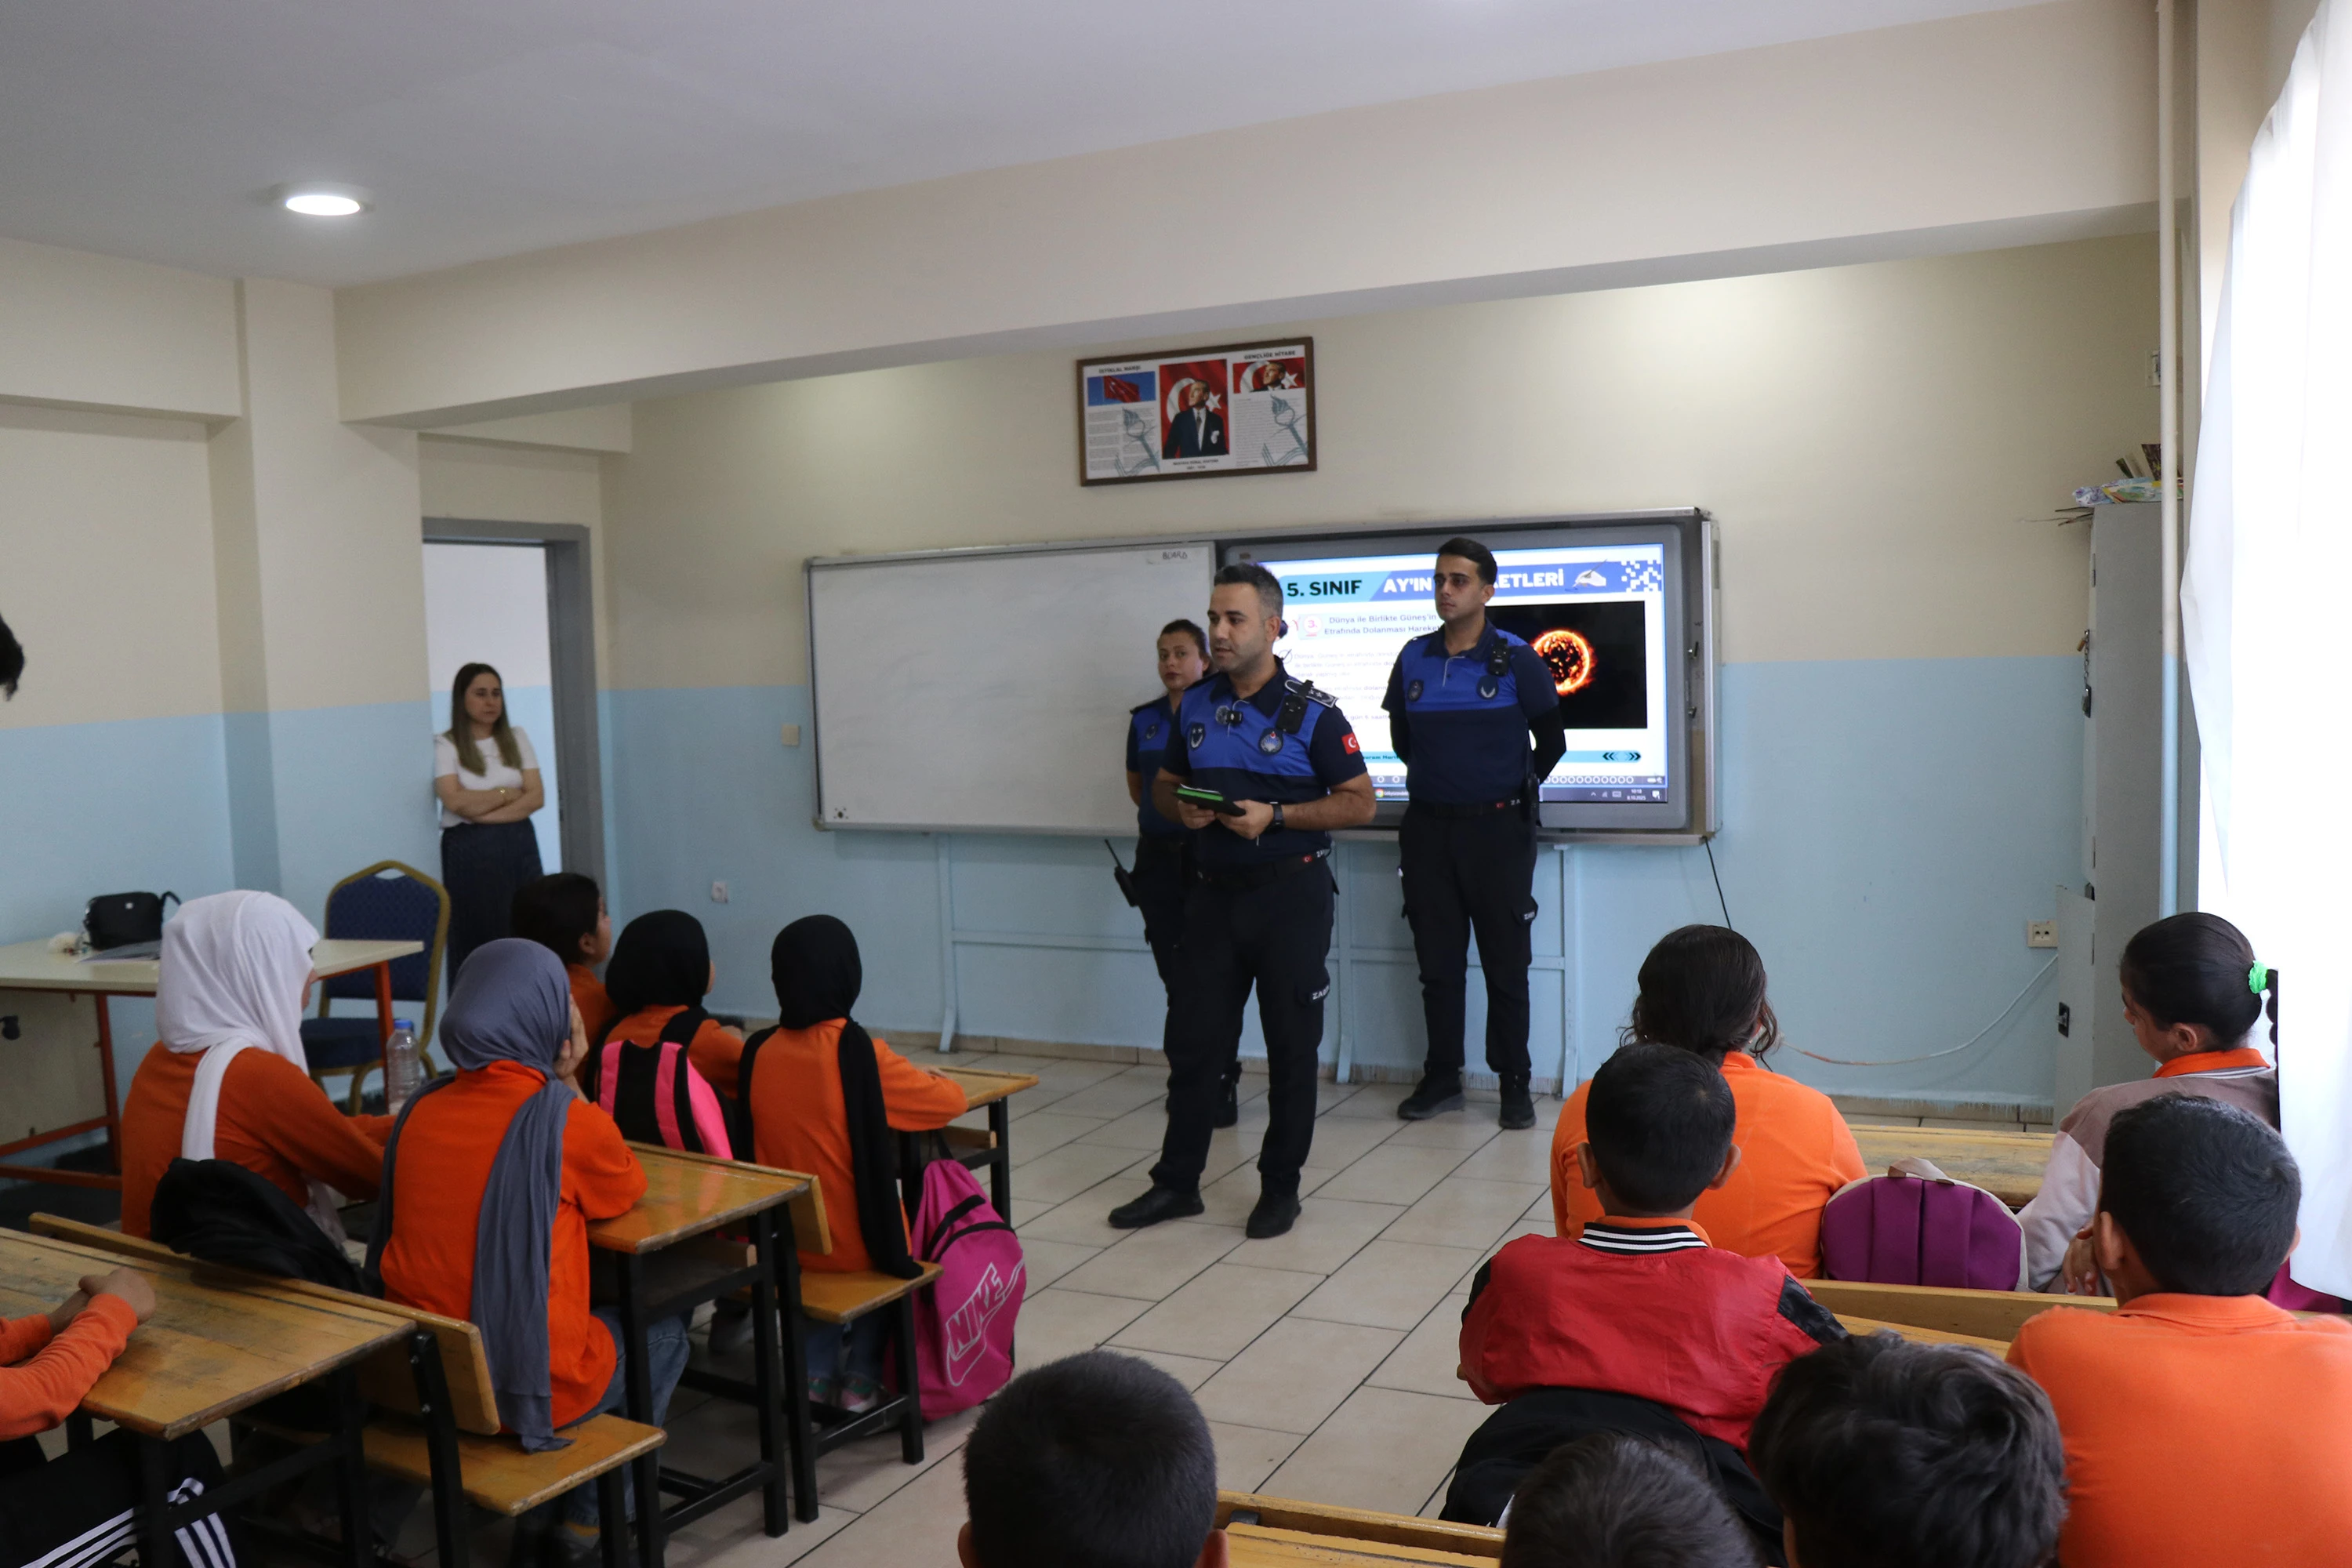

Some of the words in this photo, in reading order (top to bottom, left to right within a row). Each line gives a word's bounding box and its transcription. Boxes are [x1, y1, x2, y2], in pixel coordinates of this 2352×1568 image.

[1287, 583, 1305, 597] 5.
[1310, 579, 1363, 596] SINIF
[1383, 576, 1432, 594] AY'IN
[1494, 568, 1564, 589] ETLERİ
[1329, 615, 1356, 626] Dünya
[1357, 615, 1367, 623] ile
[1369, 614, 1399, 623] Birlikte
[1324, 627, 1361, 636] Etrafında
[1363, 626, 1406, 634] Dolanması
[945, 1261, 1005, 1359] NIKE
